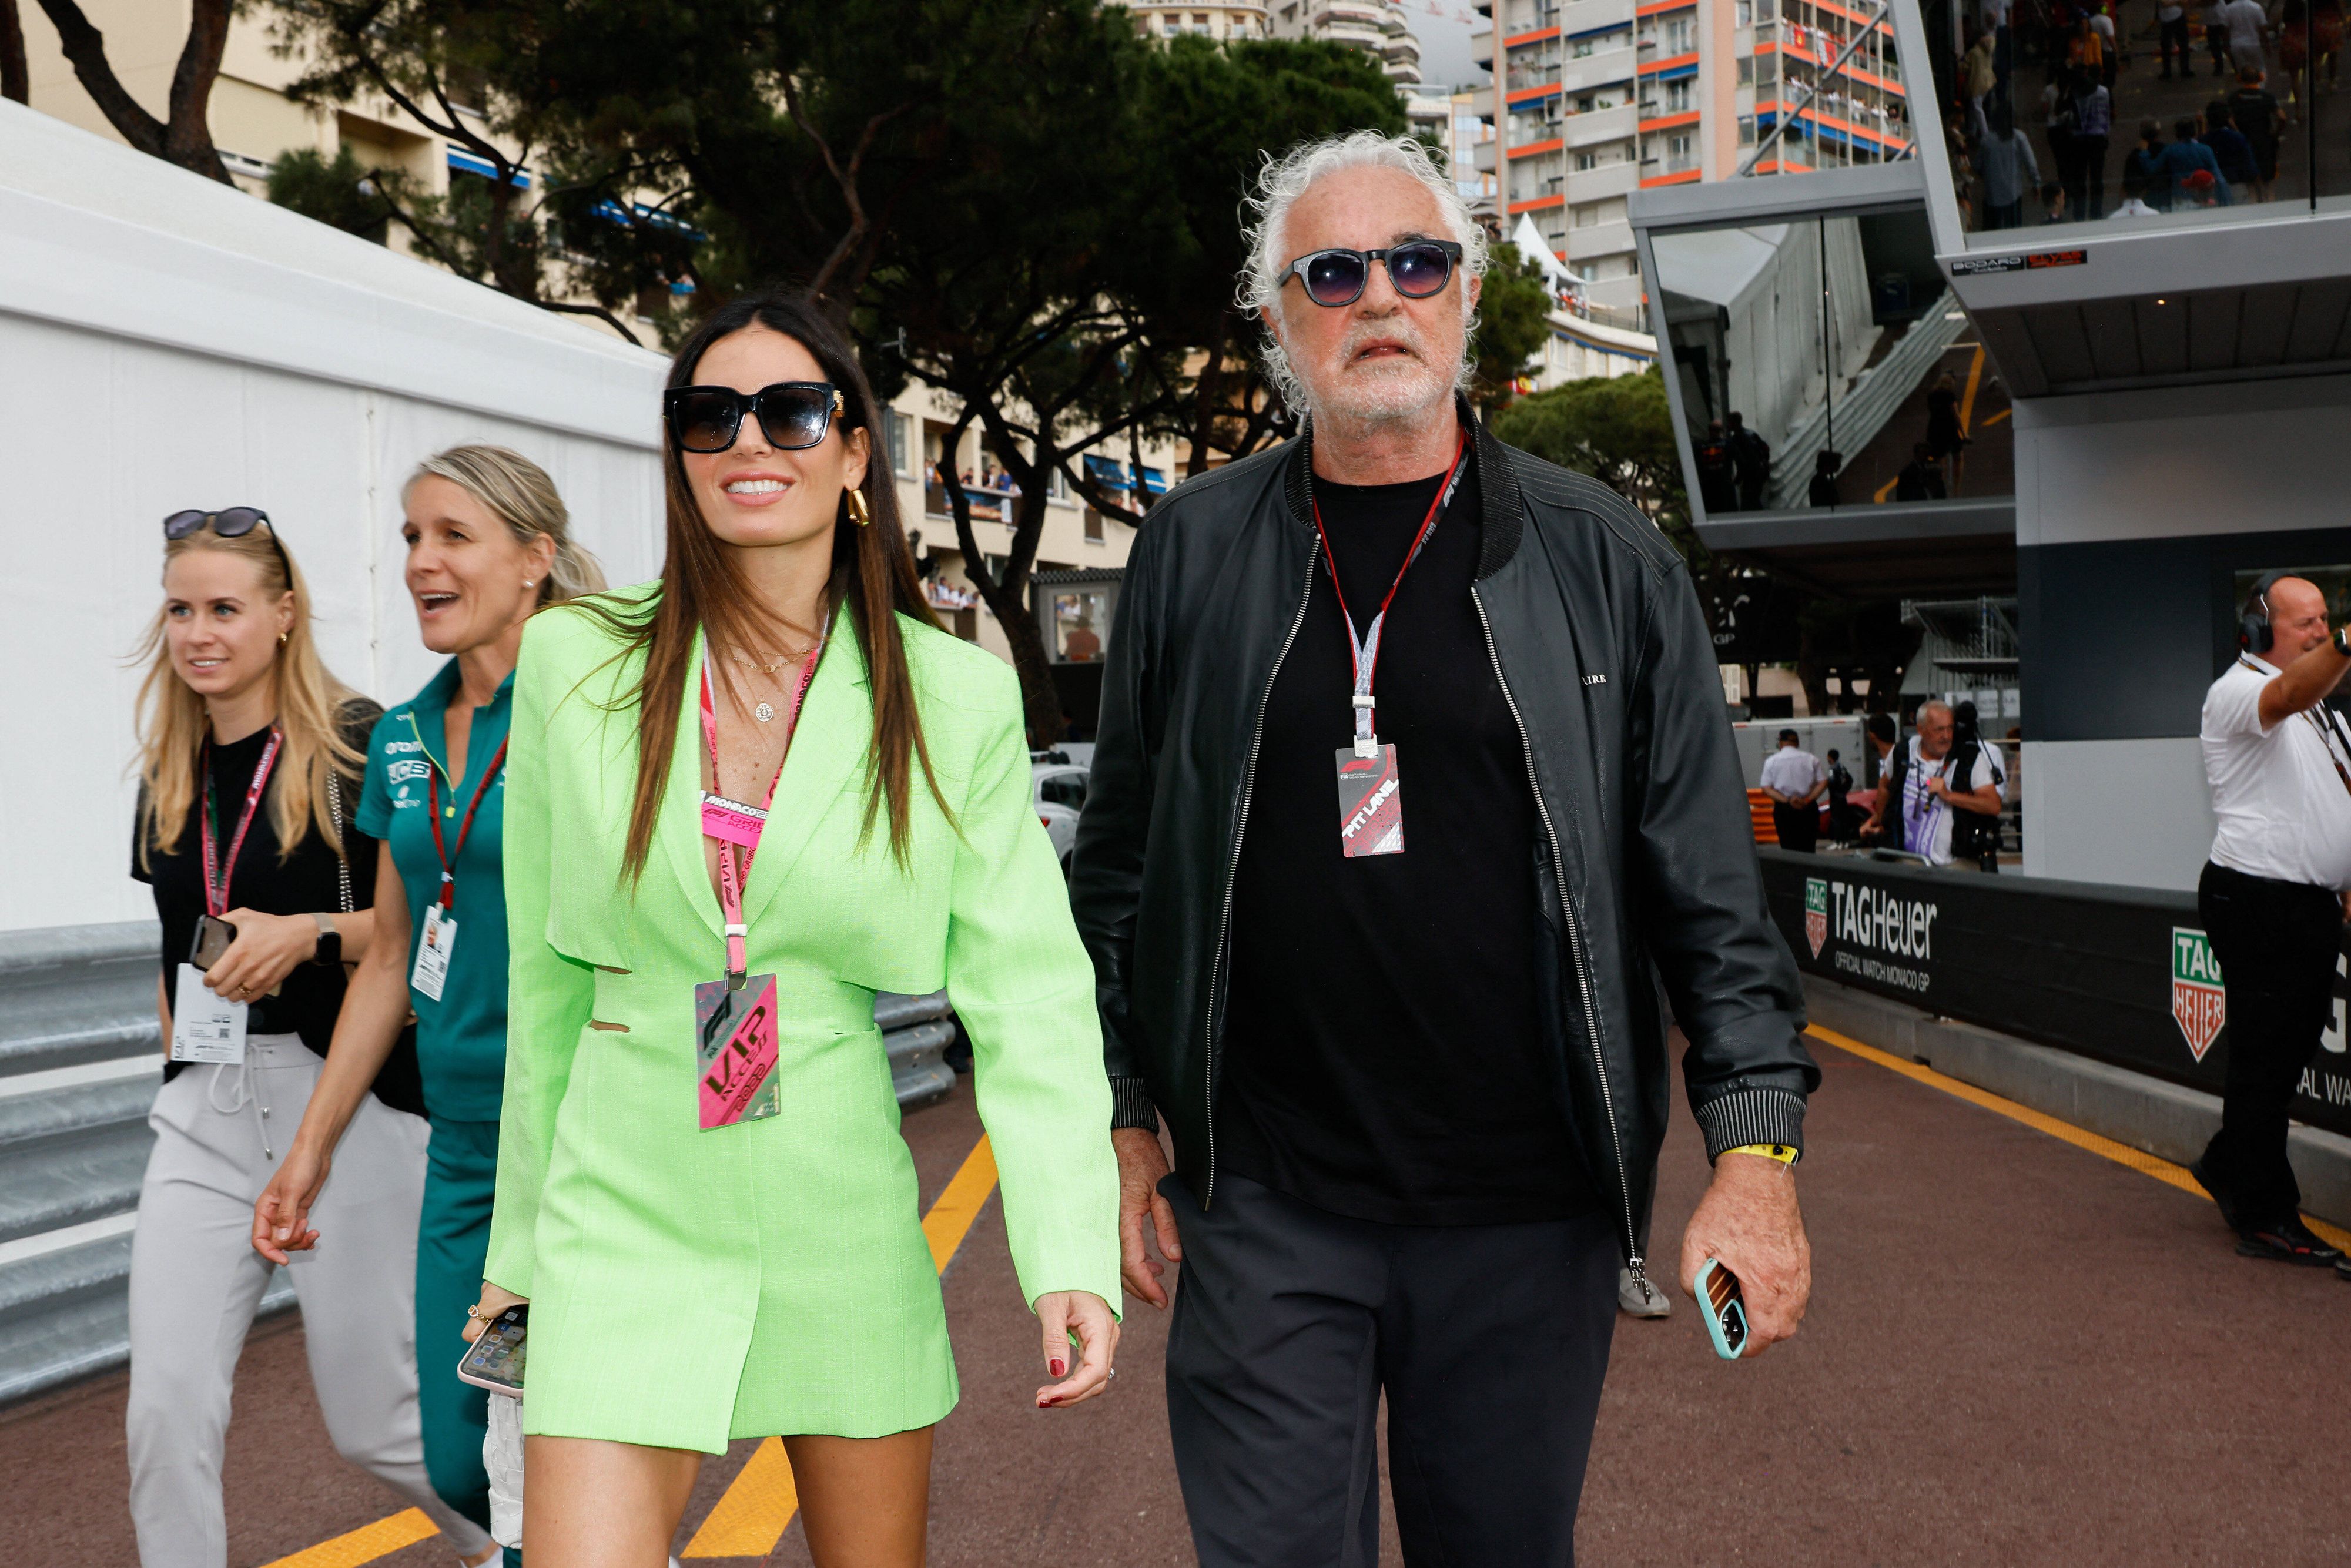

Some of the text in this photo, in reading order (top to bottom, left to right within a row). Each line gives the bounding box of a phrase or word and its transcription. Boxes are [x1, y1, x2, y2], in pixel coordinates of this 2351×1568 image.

[1341, 811, 1367, 839] PIT
[1362, 778, 1399, 817] LANE
[1808, 883, 1826, 911] TAG
[1835, 951, 1930, 992] OFFICIAL WATCH MONACO GP
[705, 1005, 766, 1095] VIP
[2175, 987, 2222, 1052] HEUER
